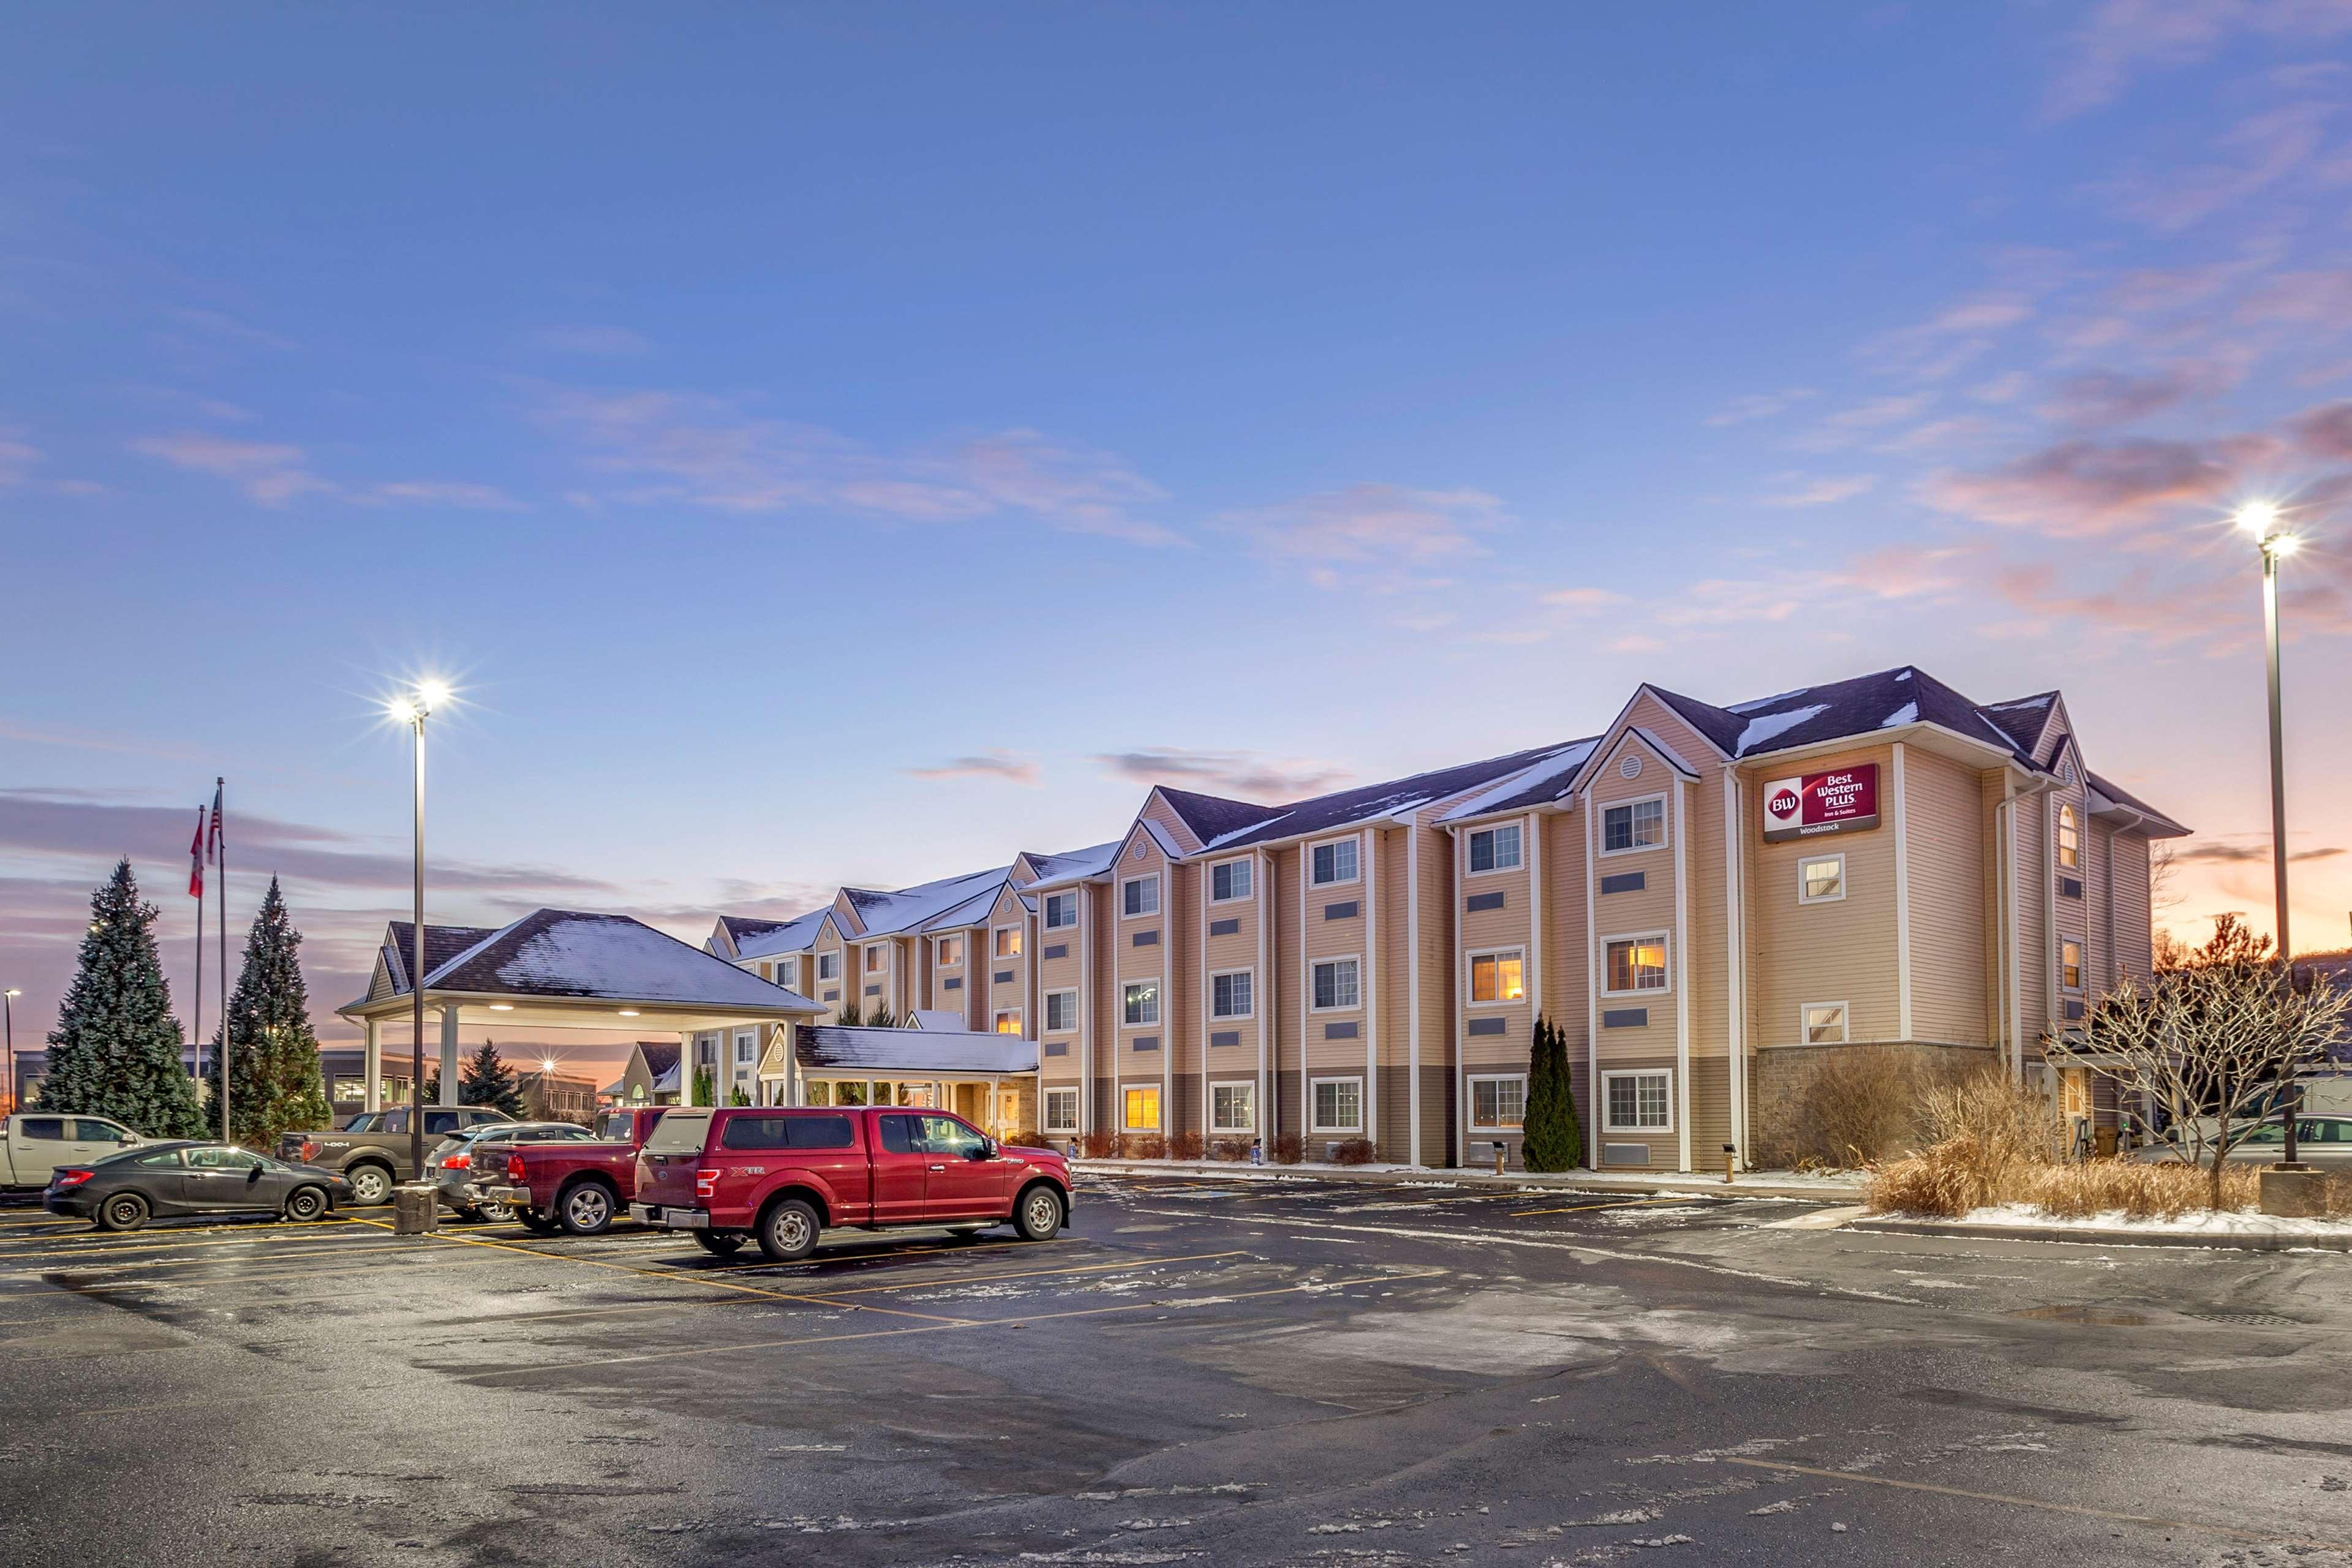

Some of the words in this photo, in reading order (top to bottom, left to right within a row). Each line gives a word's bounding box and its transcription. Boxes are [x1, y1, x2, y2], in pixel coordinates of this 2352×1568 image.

[1828, 774, 1852, 786] Best
[1817, 783, 1863, 797] Western
[1773, 796, 1795, 812] BW
[1825, 794, 1855, 807] PLUS
[1800, 823, 1839, 835] Woodstock
